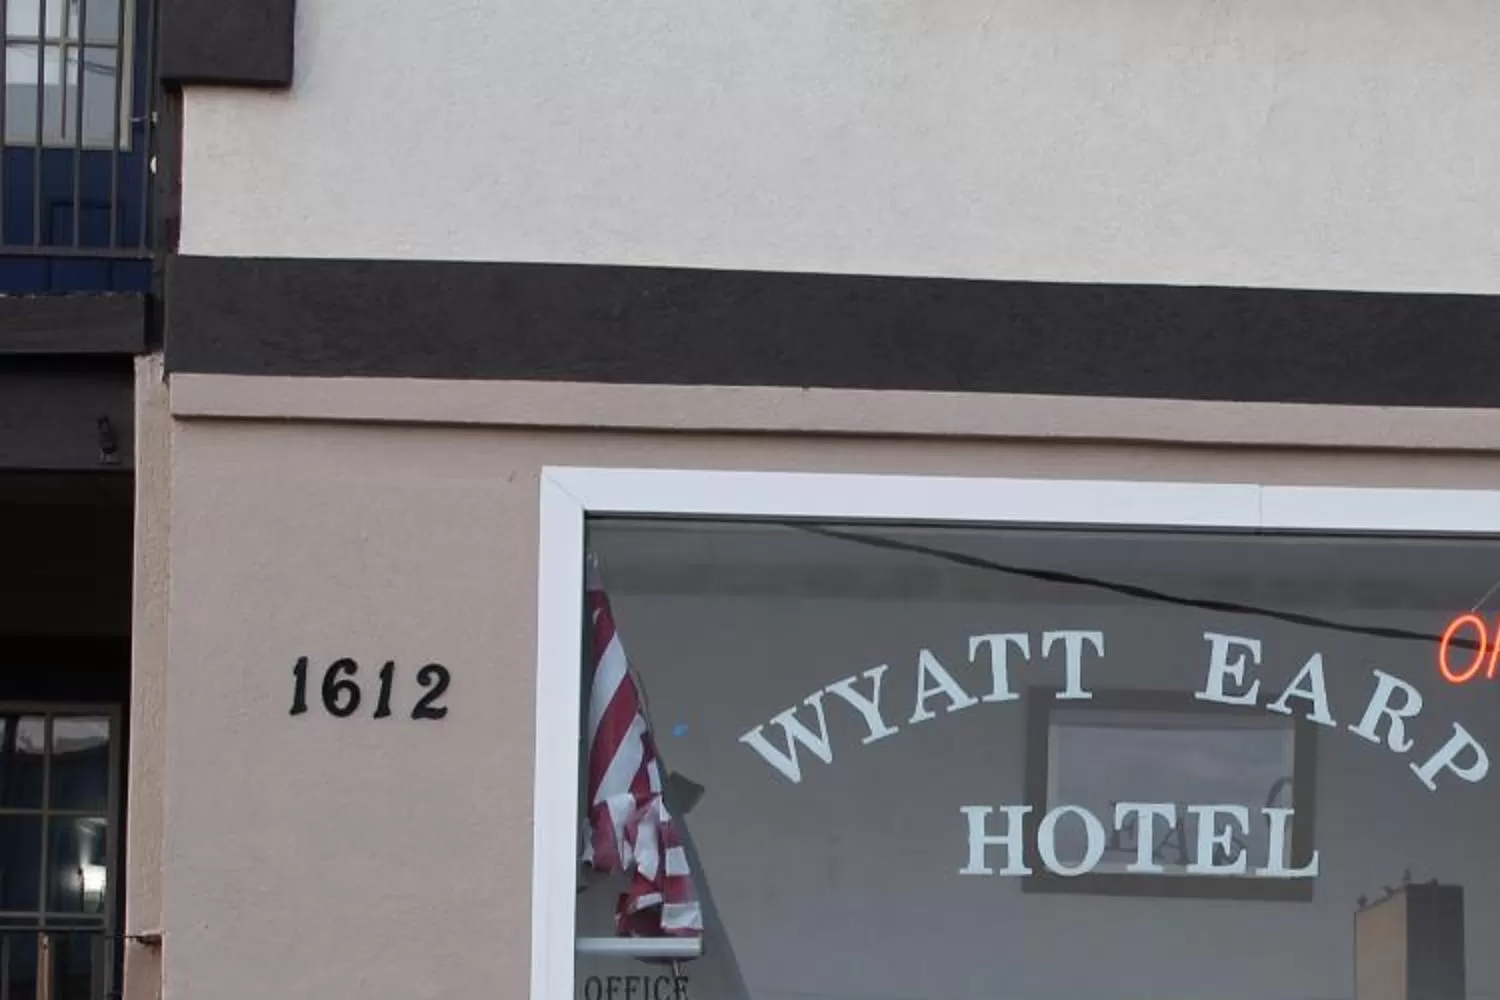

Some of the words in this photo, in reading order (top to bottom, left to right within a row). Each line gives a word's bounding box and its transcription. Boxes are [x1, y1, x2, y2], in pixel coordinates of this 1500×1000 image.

[290, 656, 450, 720] 1612
[740, 631, 1104, 782] WYATT
[1196, 633, 1488, 790] EARP
[960, 803, 1318, 876] HOTEL
